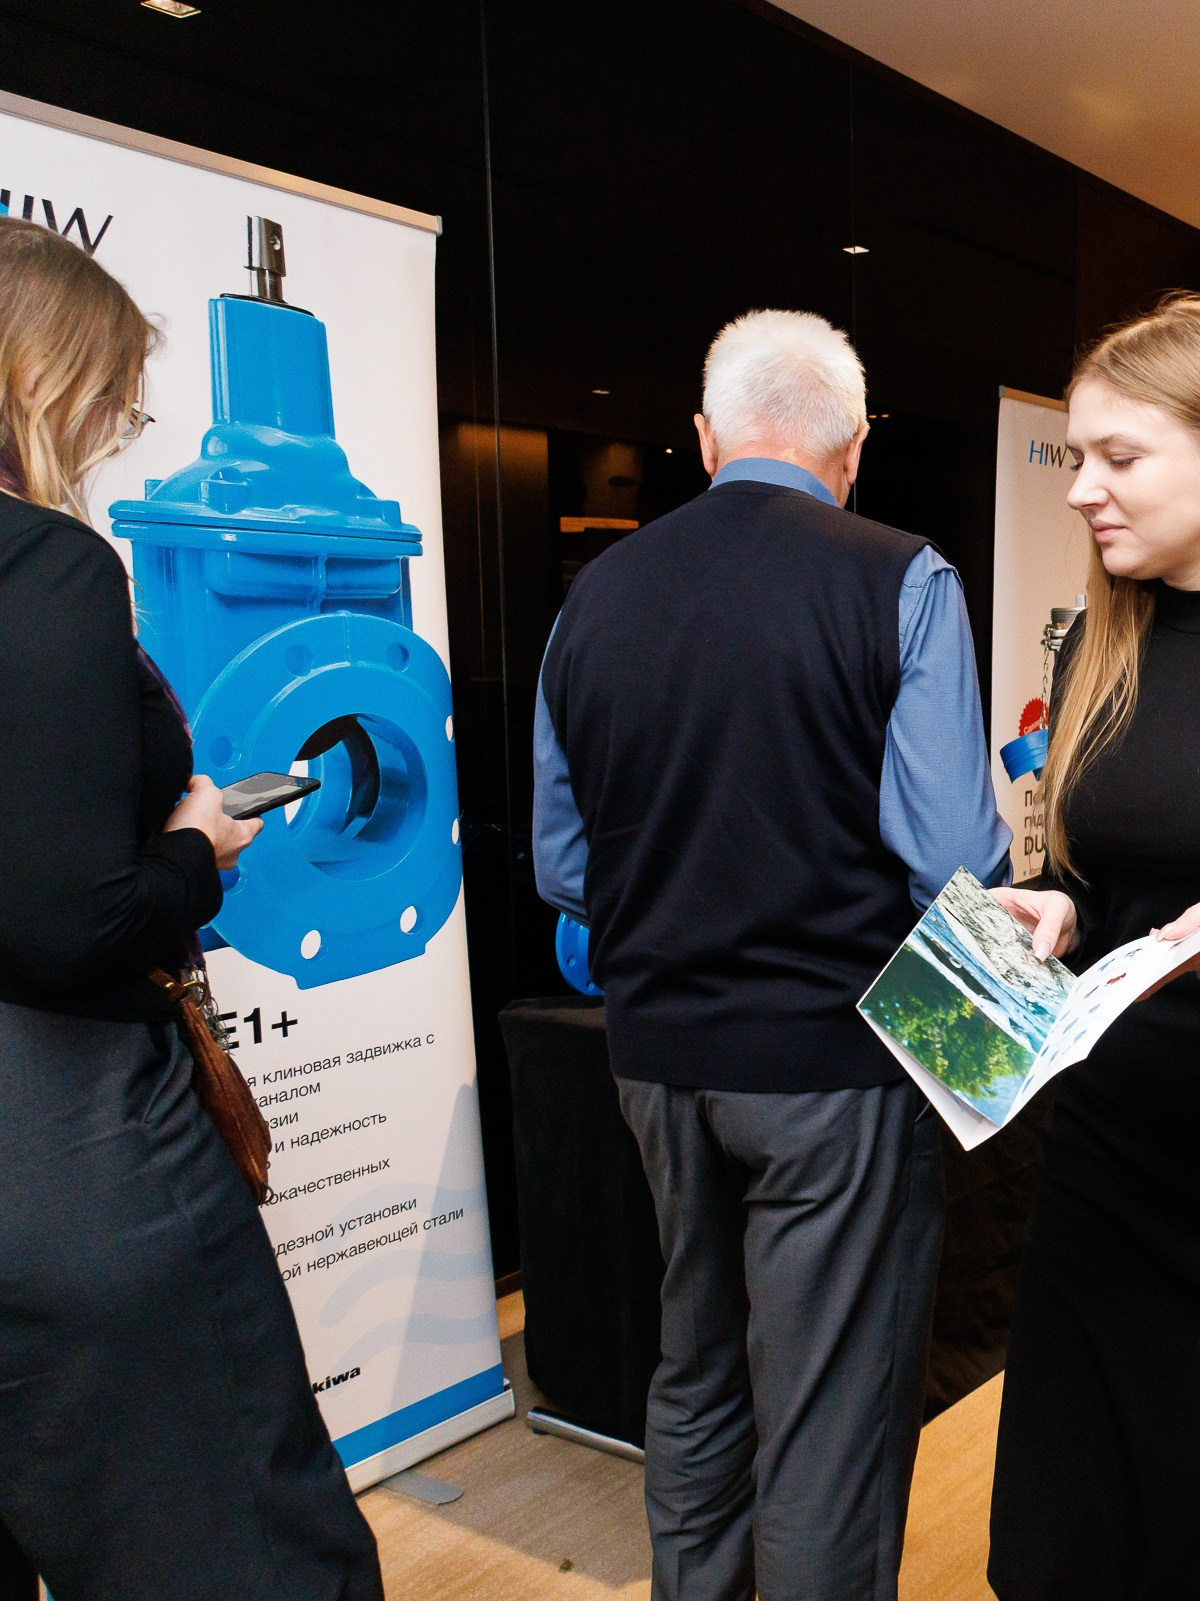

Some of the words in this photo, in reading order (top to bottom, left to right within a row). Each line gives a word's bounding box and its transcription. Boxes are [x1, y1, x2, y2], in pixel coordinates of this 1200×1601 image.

[1029, 439, 1068, 468] HIW
[263, 1056, 341, 1085] клиновая
[346, 1037, 421, 1064] задвижка
[426, 1033, 435, 1045] с
[255, 1082, 321, 1108] аналом
[265, 1112, 299, 1130] зии
[275, 1141, 285, 1154] и
[291, 1113, 387, 1149] надежность
[260, 1158, 390, 1208] окачественных
[273, 1223, 334, 1258] дезной
[339, 1198, 417, 1237] установки
[281, 1262, 302, 1281] ой
[307, 1221, 418, 1273] нержавеющей
[423, 1208, 464, 1231] стали
[312, 1366, 361, 1395] kiwa
